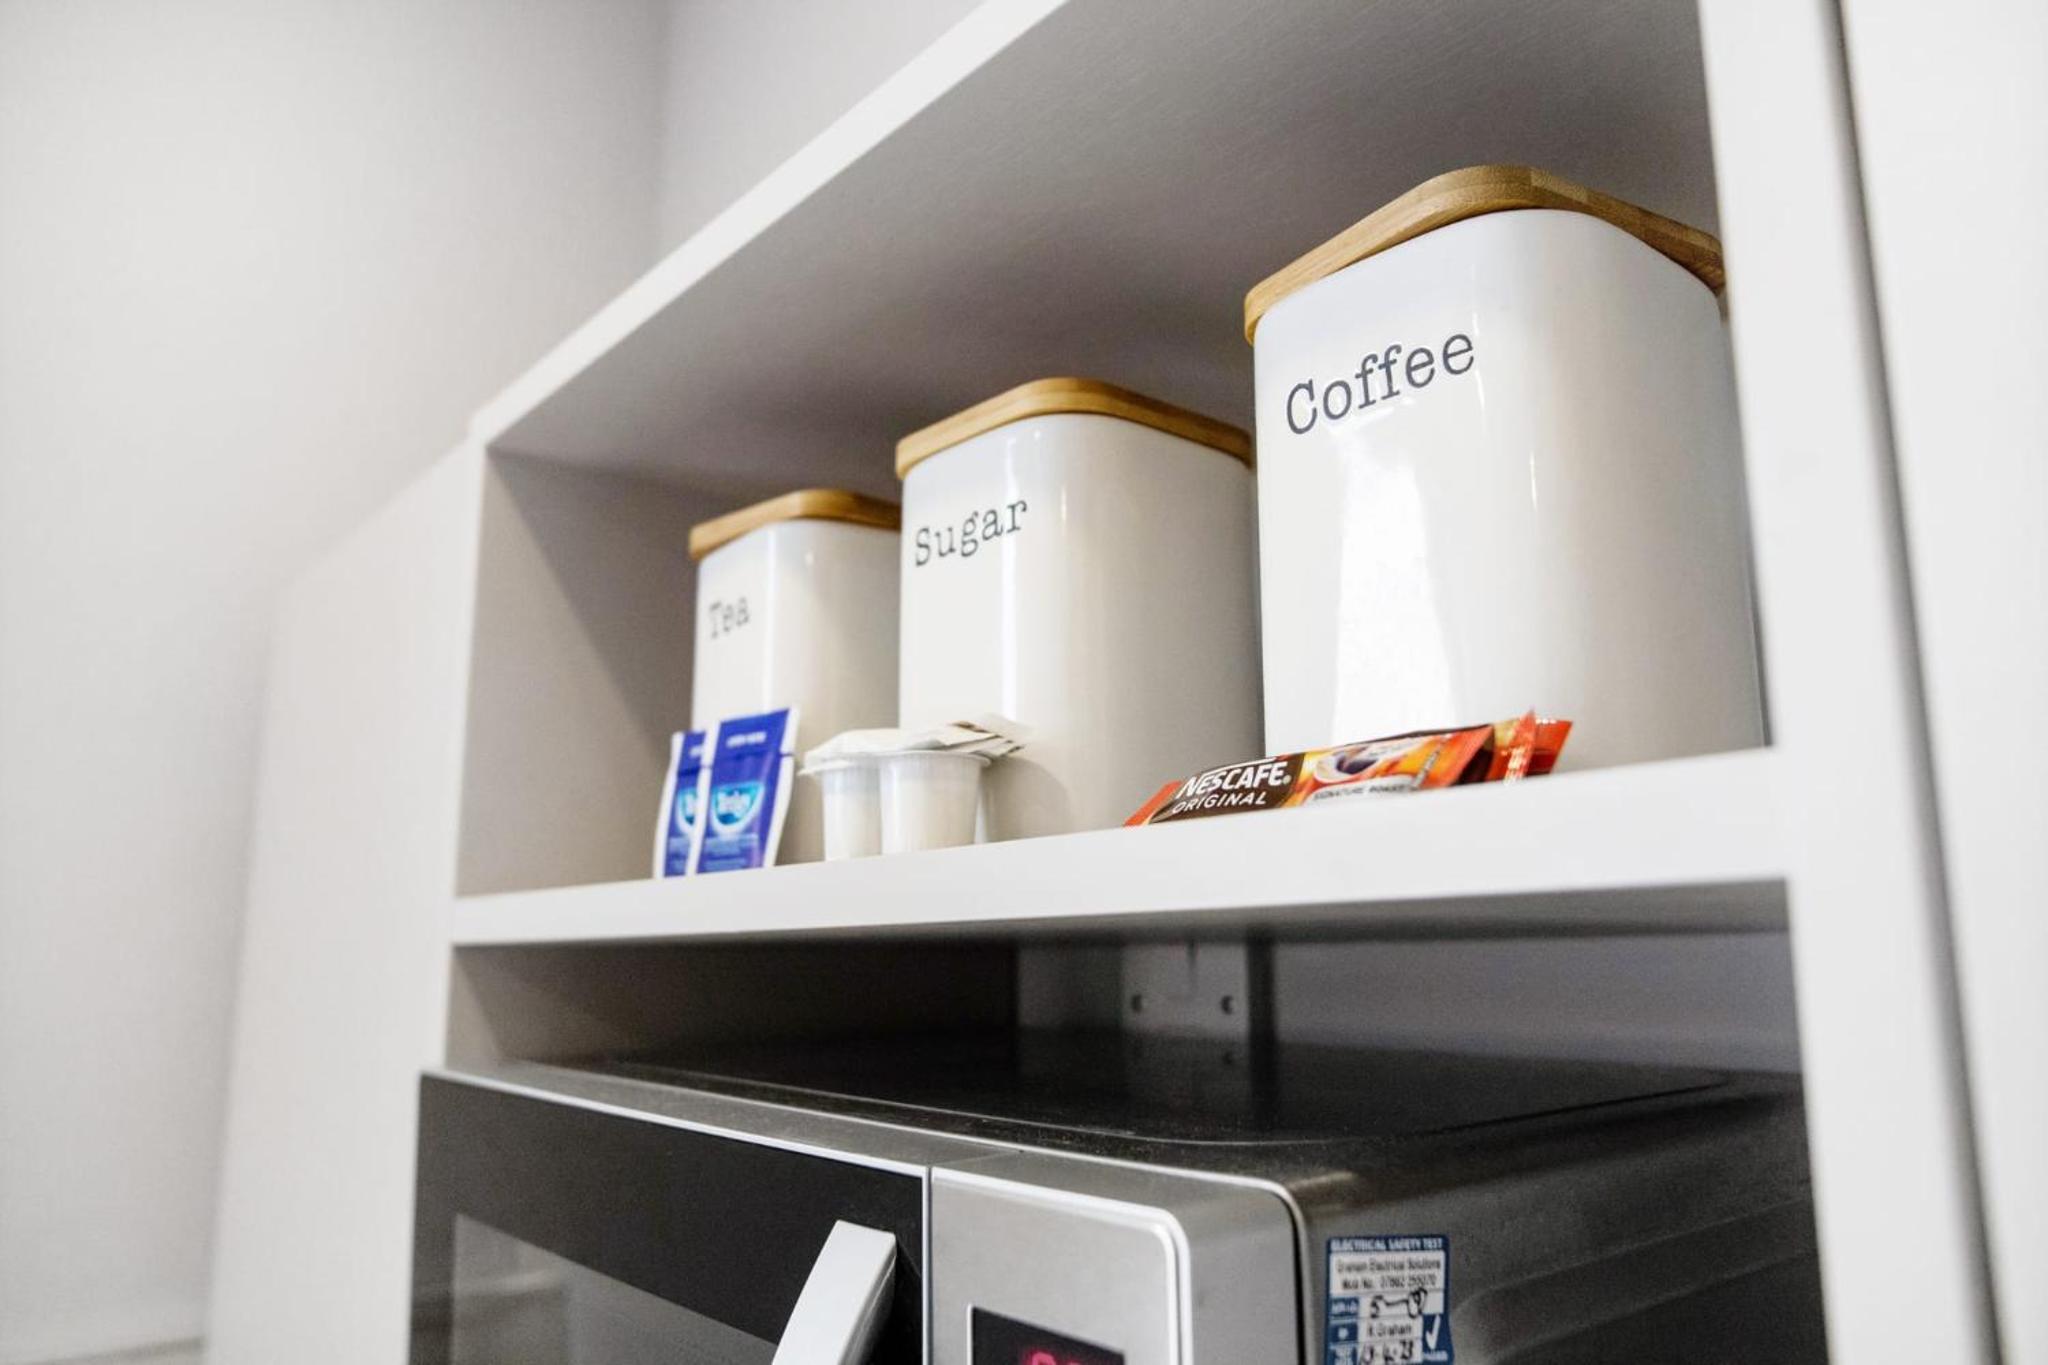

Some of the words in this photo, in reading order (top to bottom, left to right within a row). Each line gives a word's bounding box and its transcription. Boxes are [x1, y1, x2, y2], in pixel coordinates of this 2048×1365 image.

[1286, 334, 1475, 435] Coffee
[915, 500, 1027, 567] Sugar
[709, 597, 750, 641] Tea
[1172, 791, 1267, 814] ORIGINAL
